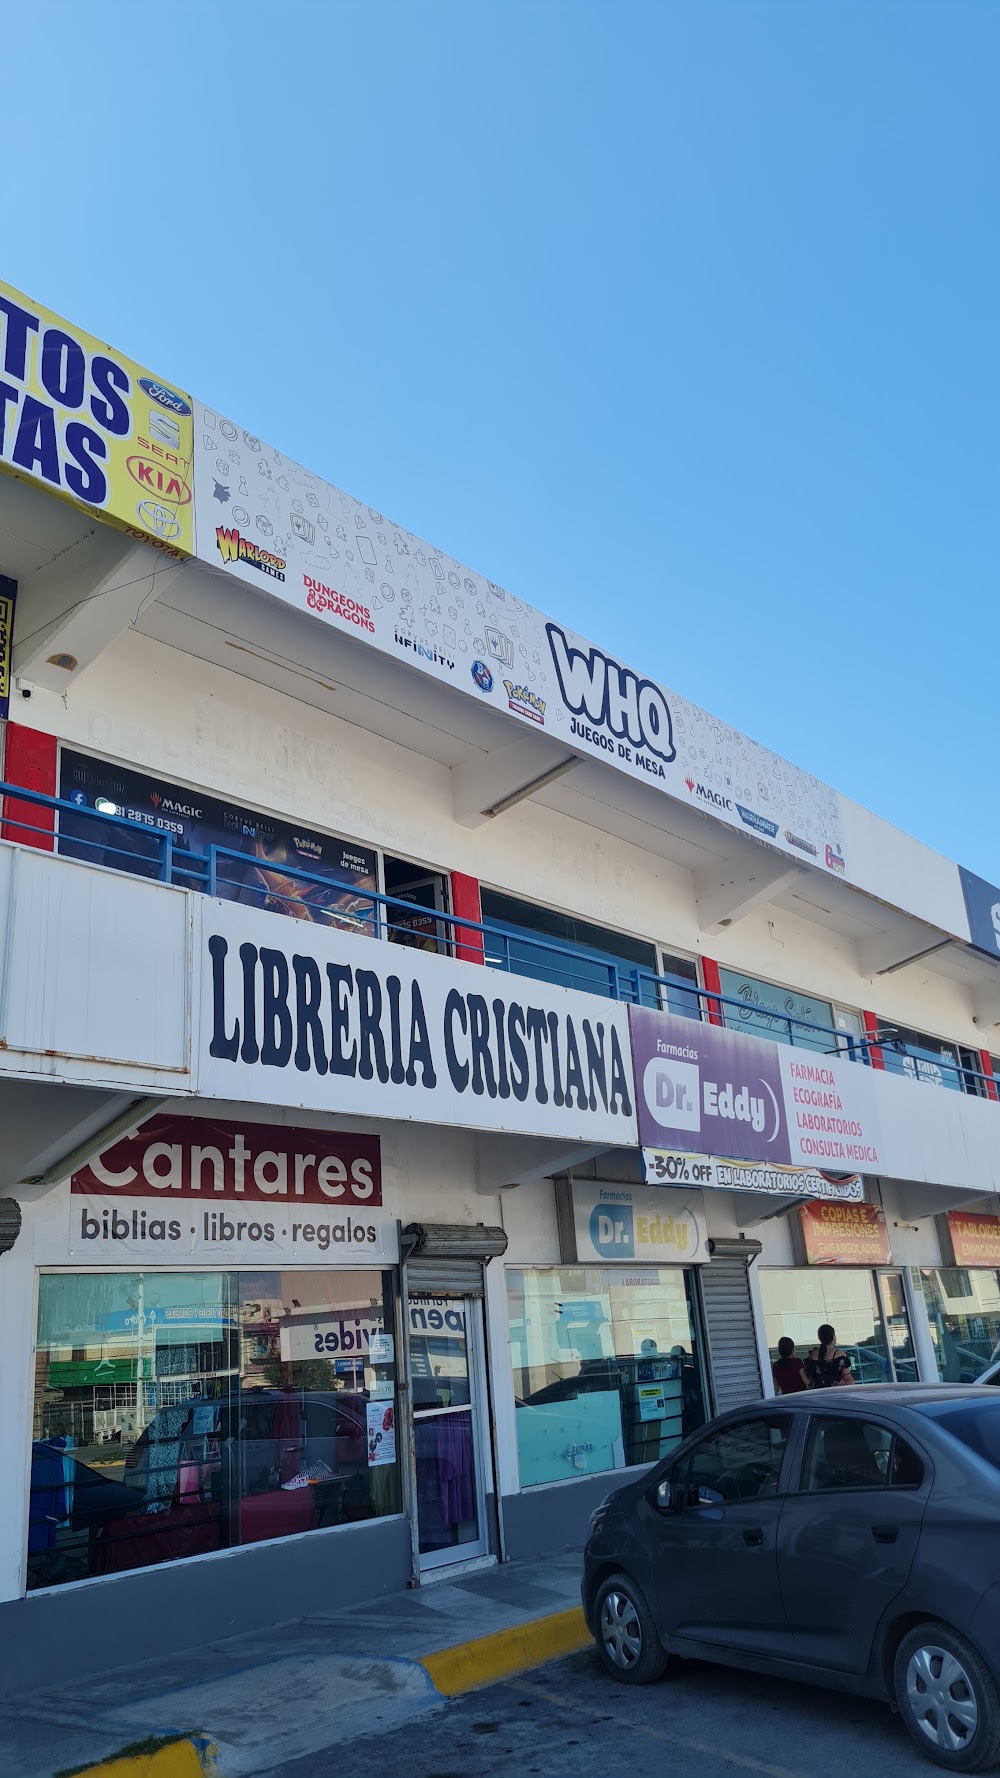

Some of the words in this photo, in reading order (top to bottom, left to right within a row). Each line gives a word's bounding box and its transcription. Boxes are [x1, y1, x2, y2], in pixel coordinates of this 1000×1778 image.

[147, 382, 183, 412] Ford
[137, 436, 190, 469] SEAT
[137, 459, 182, 499] KIA
[123, 525, 181, 558] TOYOTA
[215, 525, 286, 570] WARLORD
[302, 573, 371, 620] DUNGEONS
[570, 717, 615, 753] JUEGOS
[617, 744, 632, 763] DE
[635, 753, 666, 780] MESA
[162, 798, 203, 818] MAGIC
[696, 783, 733, 812] MAGIC
[128, 809, 155, 826] 2875
[157, 817, 184, 834] 0359
[340, 860, 350, 869] de
[350, 864, 369, 875] mesa
[208, 934, 437, 1089] LIBRERIA
[443, 988, 633, 1117] CRISTIANA
[656, 1039, 698, 1060] Farmacias
[790, 1062, 835, 1086] FARMACIA
[655, 1071, 693, 1112] Dr.
[703, 1081, 765, 1133] Eddy
[793, 1087, 843, 1110] ECOGRAFÍA
[796, 1112, 863, 1137] LABORATORIOS
[800, 1137, 845, 1159] CONSULTA
[846, 1143, 879, 1163] MEDICA
[692, 1165, 712, 1182] OFF
[716, 1165, 732, 1185] EN
[732, 1167, 805, 1192] LABORATORIOS
[600, 1190, 632, 1201] Farmacias
[820, 1206, 859, 1223] COPIAS
[860, 1208, 869, 1223] E
[81, 1208, 181, 1240] biblias
[203, 1212, 275, 1241] libros
[292, 1217, 377, 1250] regalos
[598, 1215, 629, 1244] Dr.
[636, 1215, 687, 1251] Eddy
[812, 1221, 880, 1238] IMPRESIONES
[818, 1242, 881, 1254] ENGARGOLADOS
